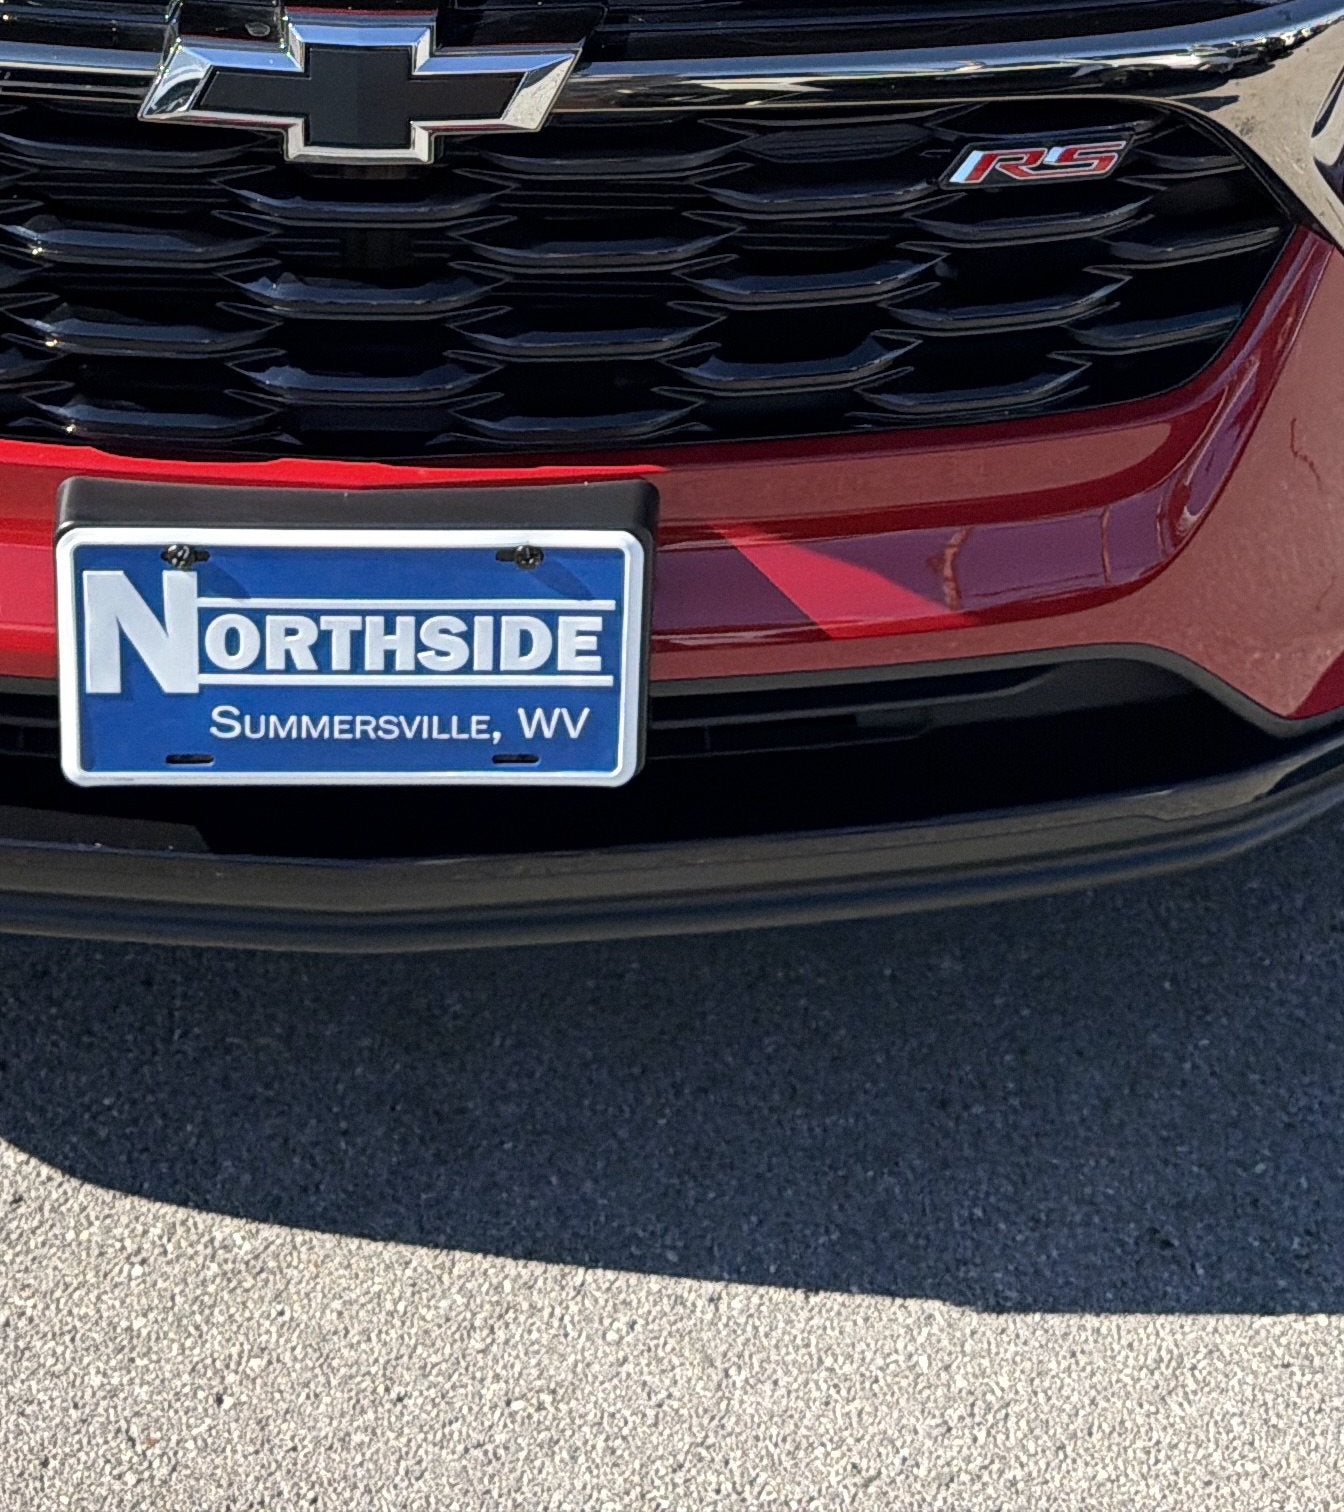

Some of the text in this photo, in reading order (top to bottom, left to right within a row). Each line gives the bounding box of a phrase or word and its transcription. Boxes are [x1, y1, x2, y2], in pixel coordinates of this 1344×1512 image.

[949, 140, 1127, 184] RS
[82, 569, 603, 695] NORTHSIDE
[517, 706, 591, 740] WV
